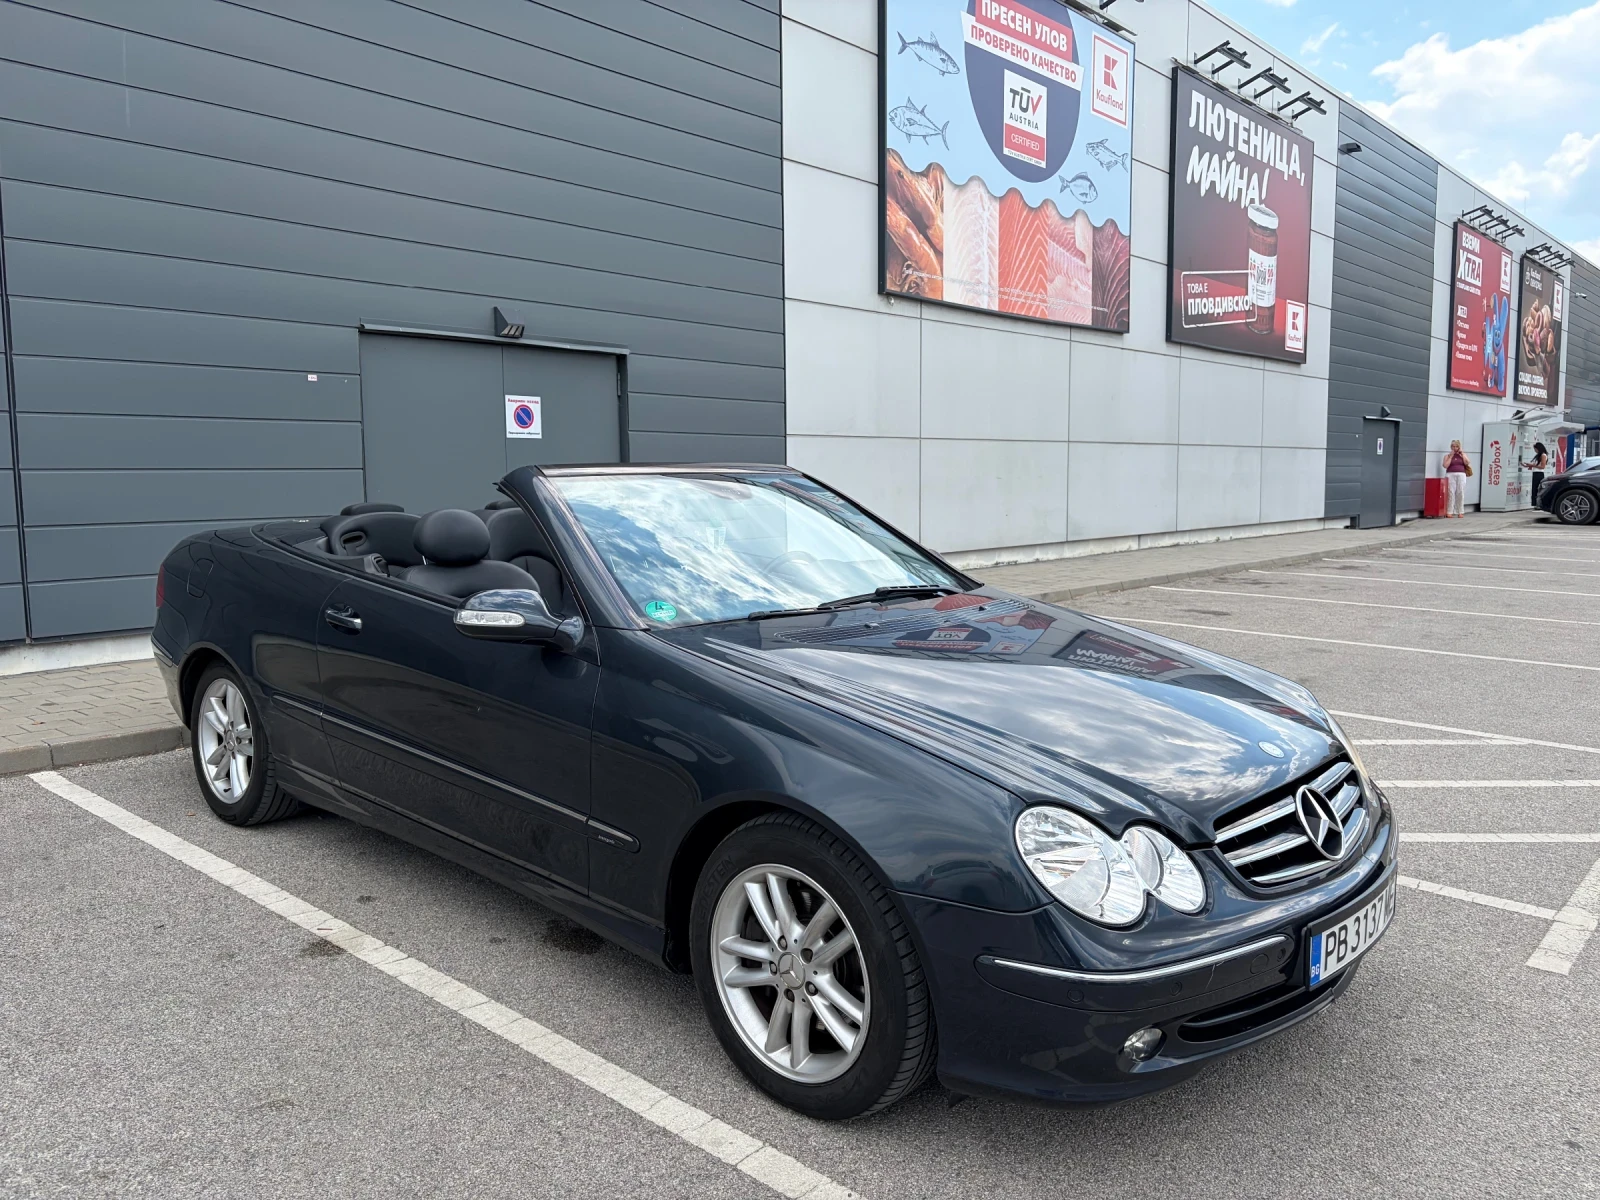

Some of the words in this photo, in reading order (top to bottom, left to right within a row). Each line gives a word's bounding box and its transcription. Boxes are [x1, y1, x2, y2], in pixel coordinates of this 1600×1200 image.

[981, 0, 1031, 36] ПРЕСЕН
[1034, 21, 1067, 52] УЛОВ
[971, 25, 1029, 62] ПРОВЕРЕНО
[1031, 52, 1076, 83] КАЧЕСТВО
[1096, 89, 1123, 110] Kaufland
[1009, 112, 1039, 130] AUSTRIA
[1010, 133, 1040, 151] CERTIFIED
[1189, 90, 1305, 186] ЛЮТЕНИЦА,
[1186, 144, 1270, 208] МАЙНА!
[1187, 283, 1203, 294] ТОВА
[1204, 285, 1209, 294] Е
[1493, 446, 1502, 486] easybox
[1311, 964, 1320, 977] BG
